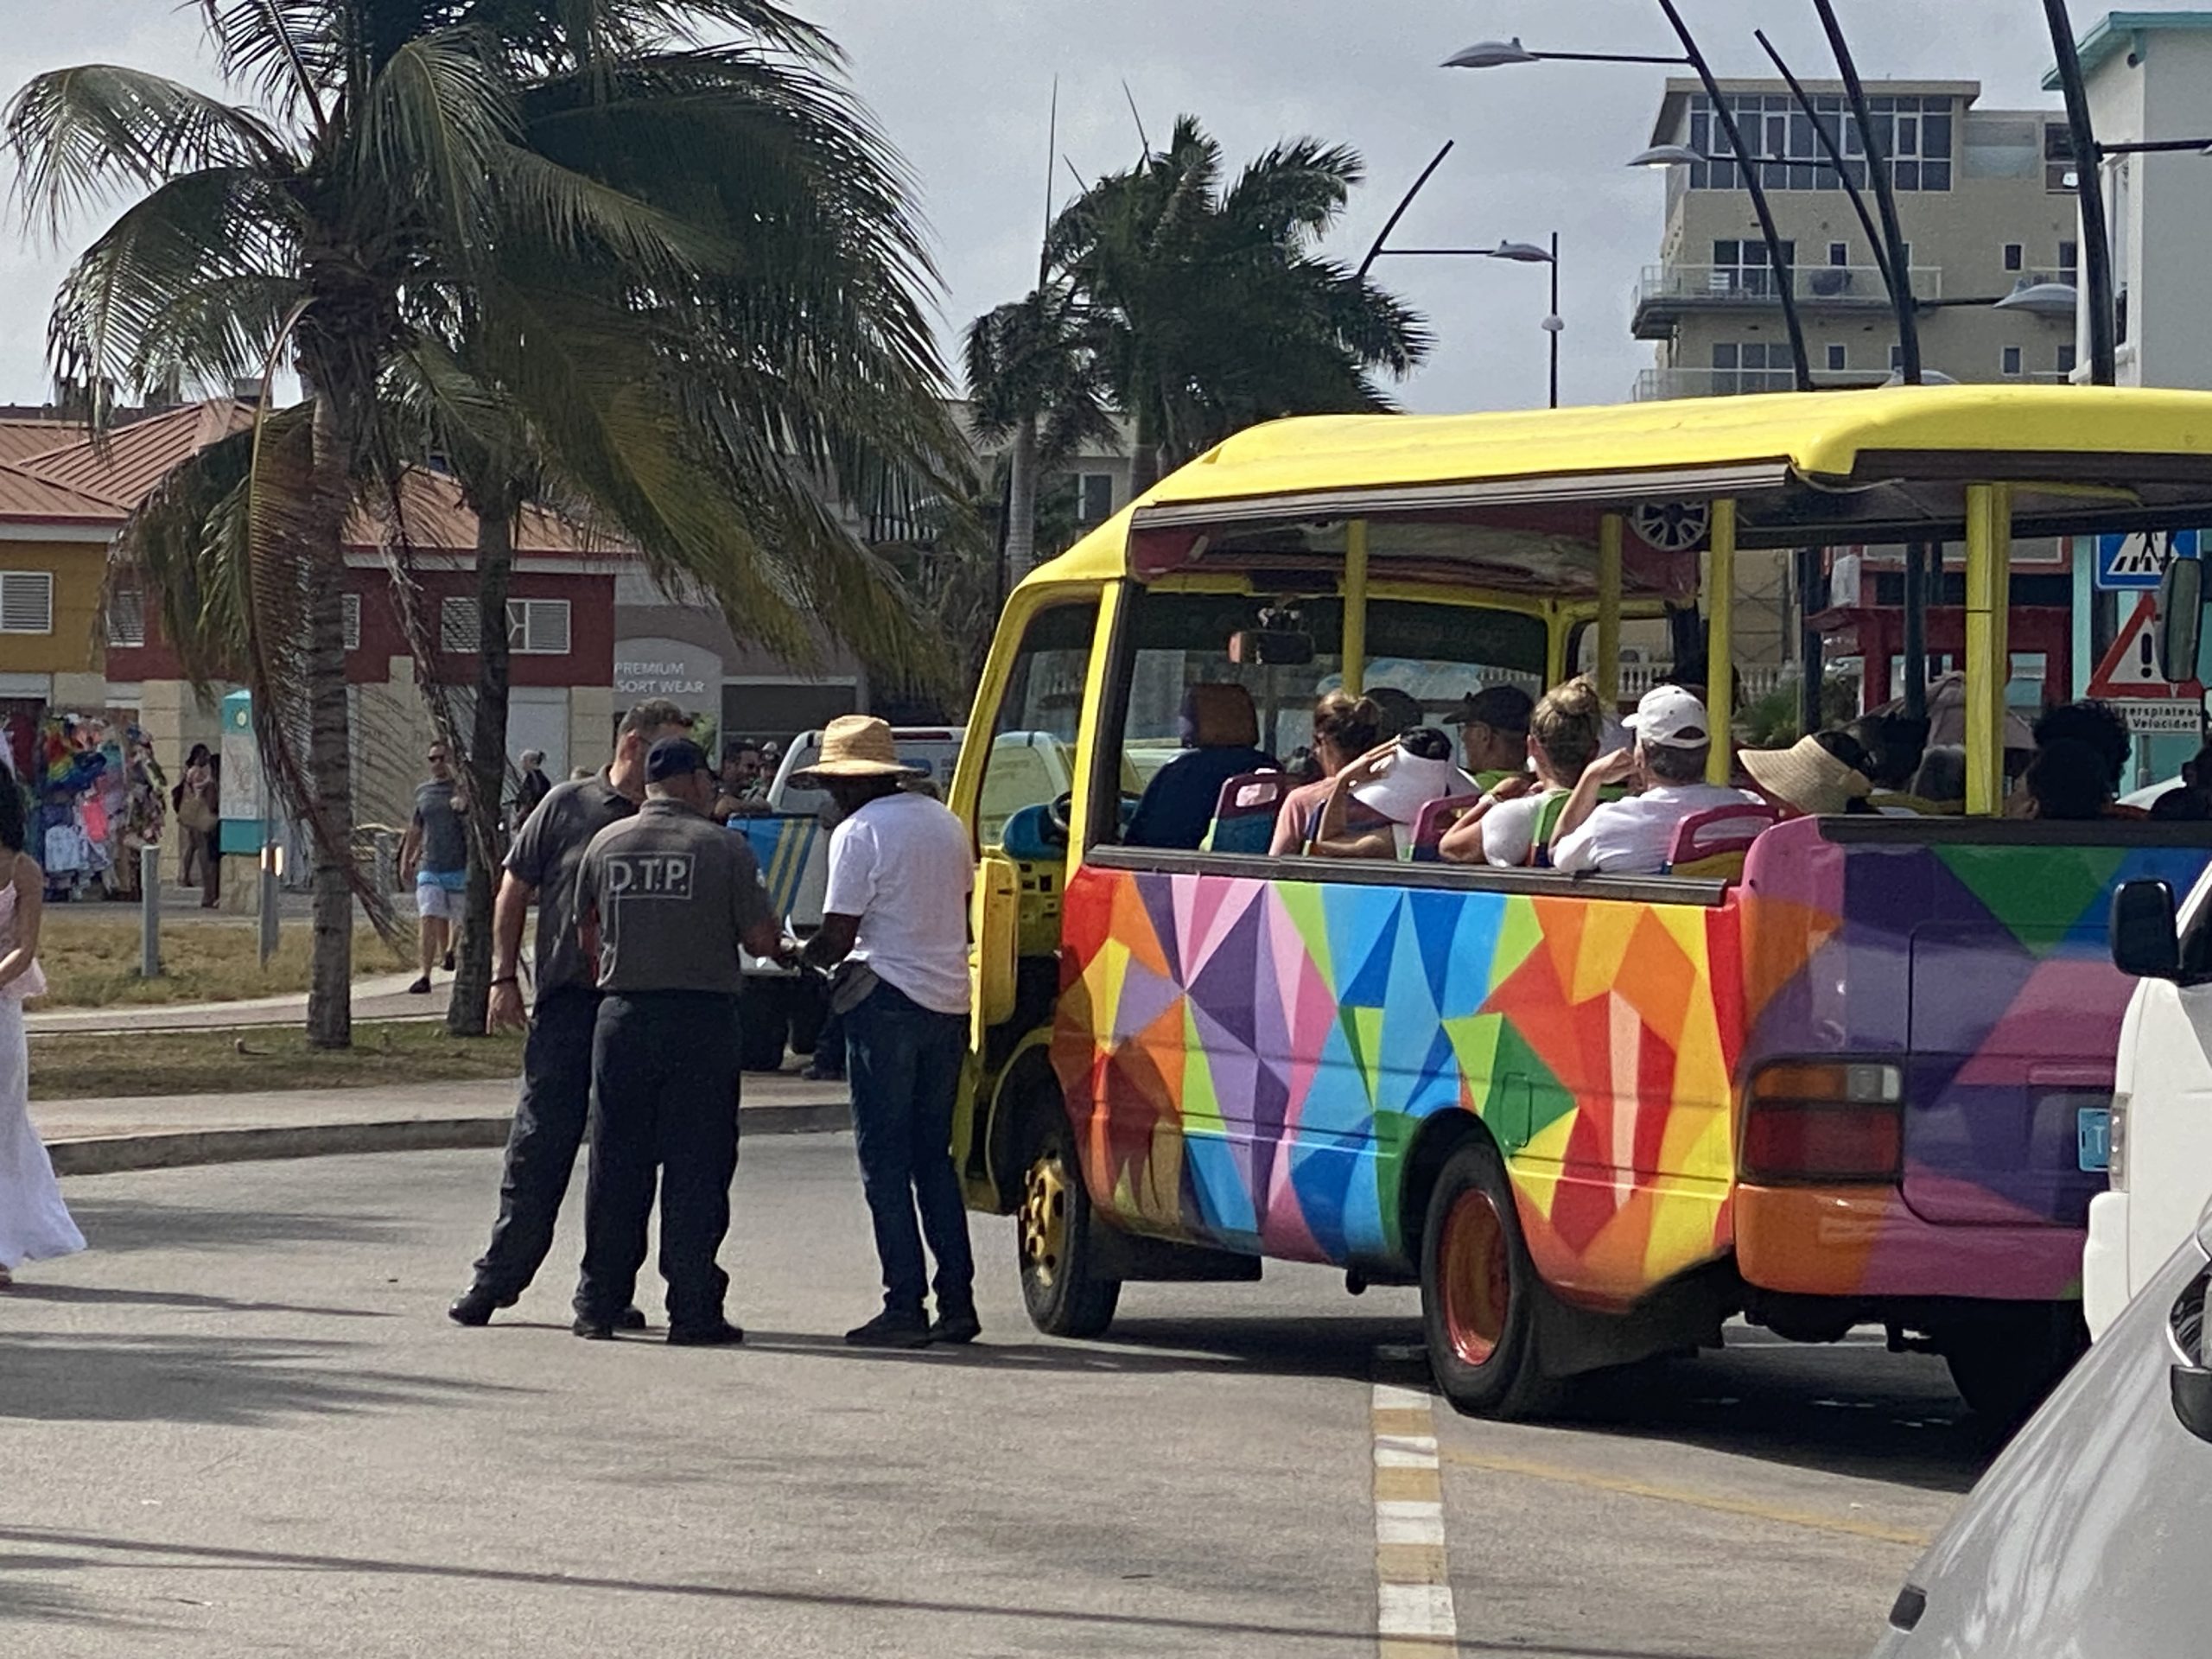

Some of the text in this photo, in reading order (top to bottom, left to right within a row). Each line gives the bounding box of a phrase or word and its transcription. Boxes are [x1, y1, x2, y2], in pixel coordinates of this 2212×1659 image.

[614, 662, 684, 676] PREMIUM
[616, 680, 705, 693] SORT WEAR
[2133, 718, 2196, 728] Velocidad
